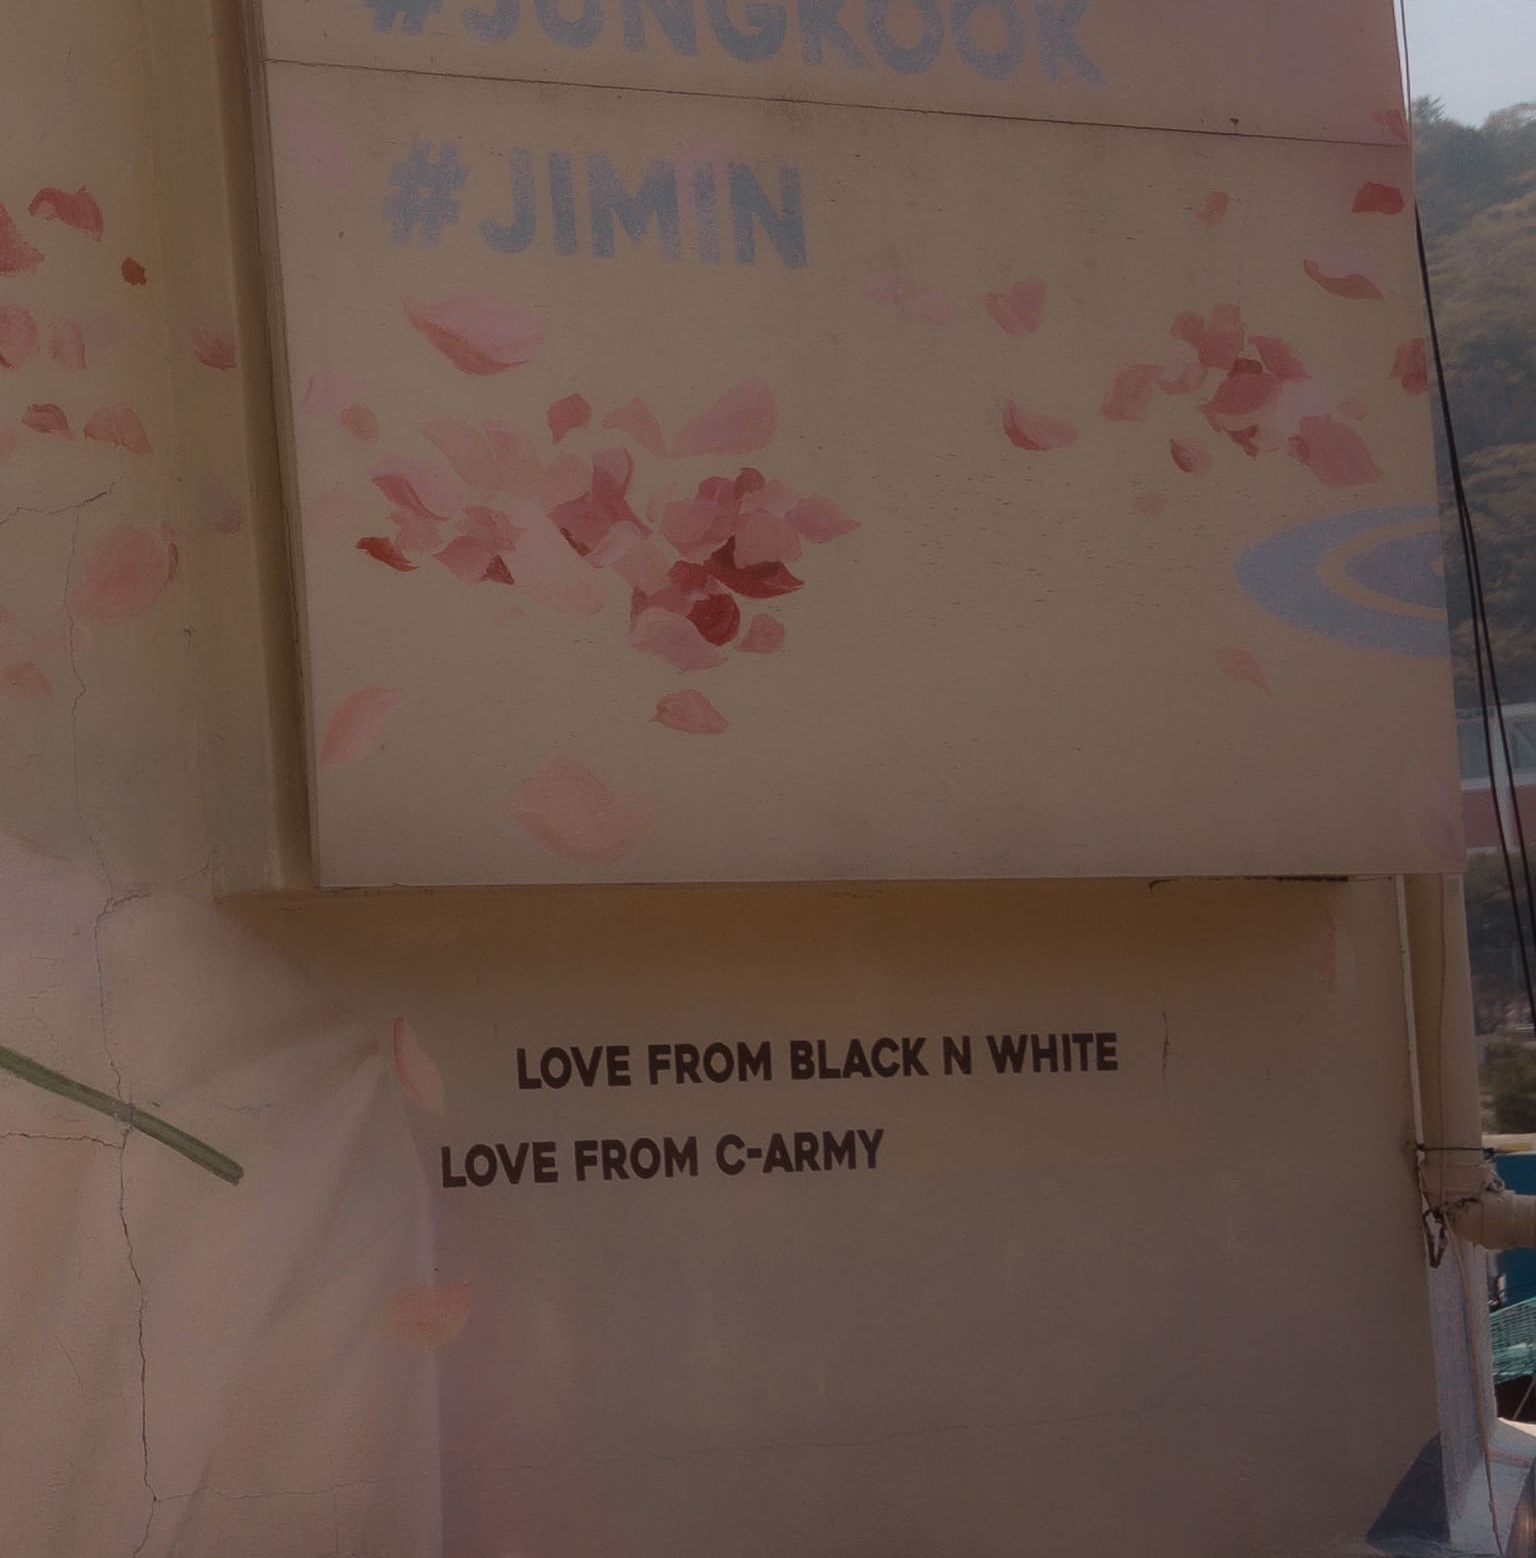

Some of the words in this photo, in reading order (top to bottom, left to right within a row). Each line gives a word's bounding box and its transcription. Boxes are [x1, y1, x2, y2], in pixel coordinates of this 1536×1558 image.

[382, 141, 809, 268] #JIMIN
[517, 1045, 630, 1090] LOVE
[647, 1041, 772, 1085] FROM
[790, 1037, 929, 1080] BLACK
[943, 1036, 972, 1075] N
[986, 1032, 1119, 1074] WHITE
[441, 1141, 559, 1189] LOVE
[574, 1136, 698, 1182] FROM
[715, 1129, 884, 1176] C-ARMY
